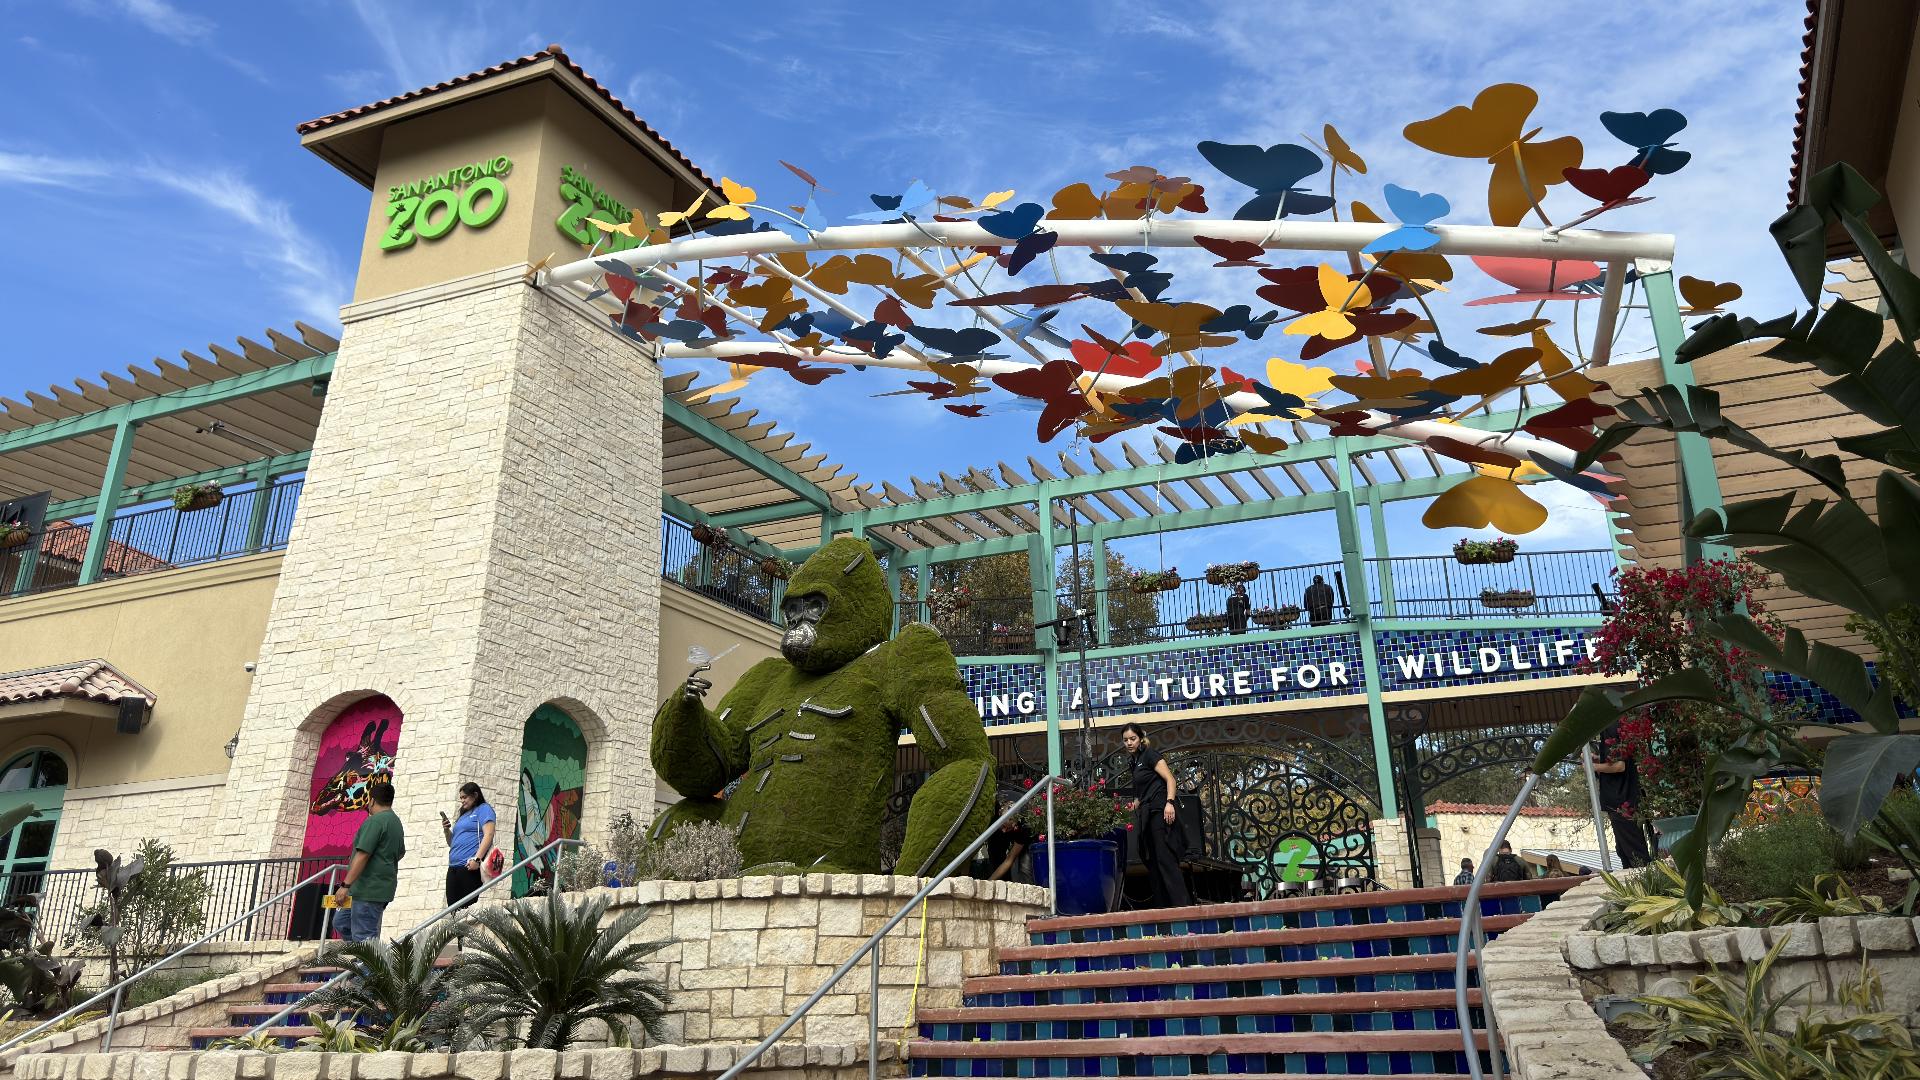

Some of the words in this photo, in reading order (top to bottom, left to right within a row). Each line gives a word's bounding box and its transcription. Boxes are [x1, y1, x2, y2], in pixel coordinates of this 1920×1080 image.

[380, 176, 508, 251] ZOO
[388, 179, 425, 203] SAN
[423, 155, 512, 195] ANTONIO
[560, 163, 596, 200] SAN
[556, 183, 650, 254] ZO
[977, 691, 1036, 718] ING
[1106, 670, 1253, 707] FUTURE
[1270, 661, 1349, 692] FOR
[1396, 637, 1602, 680] WILDLIFE
